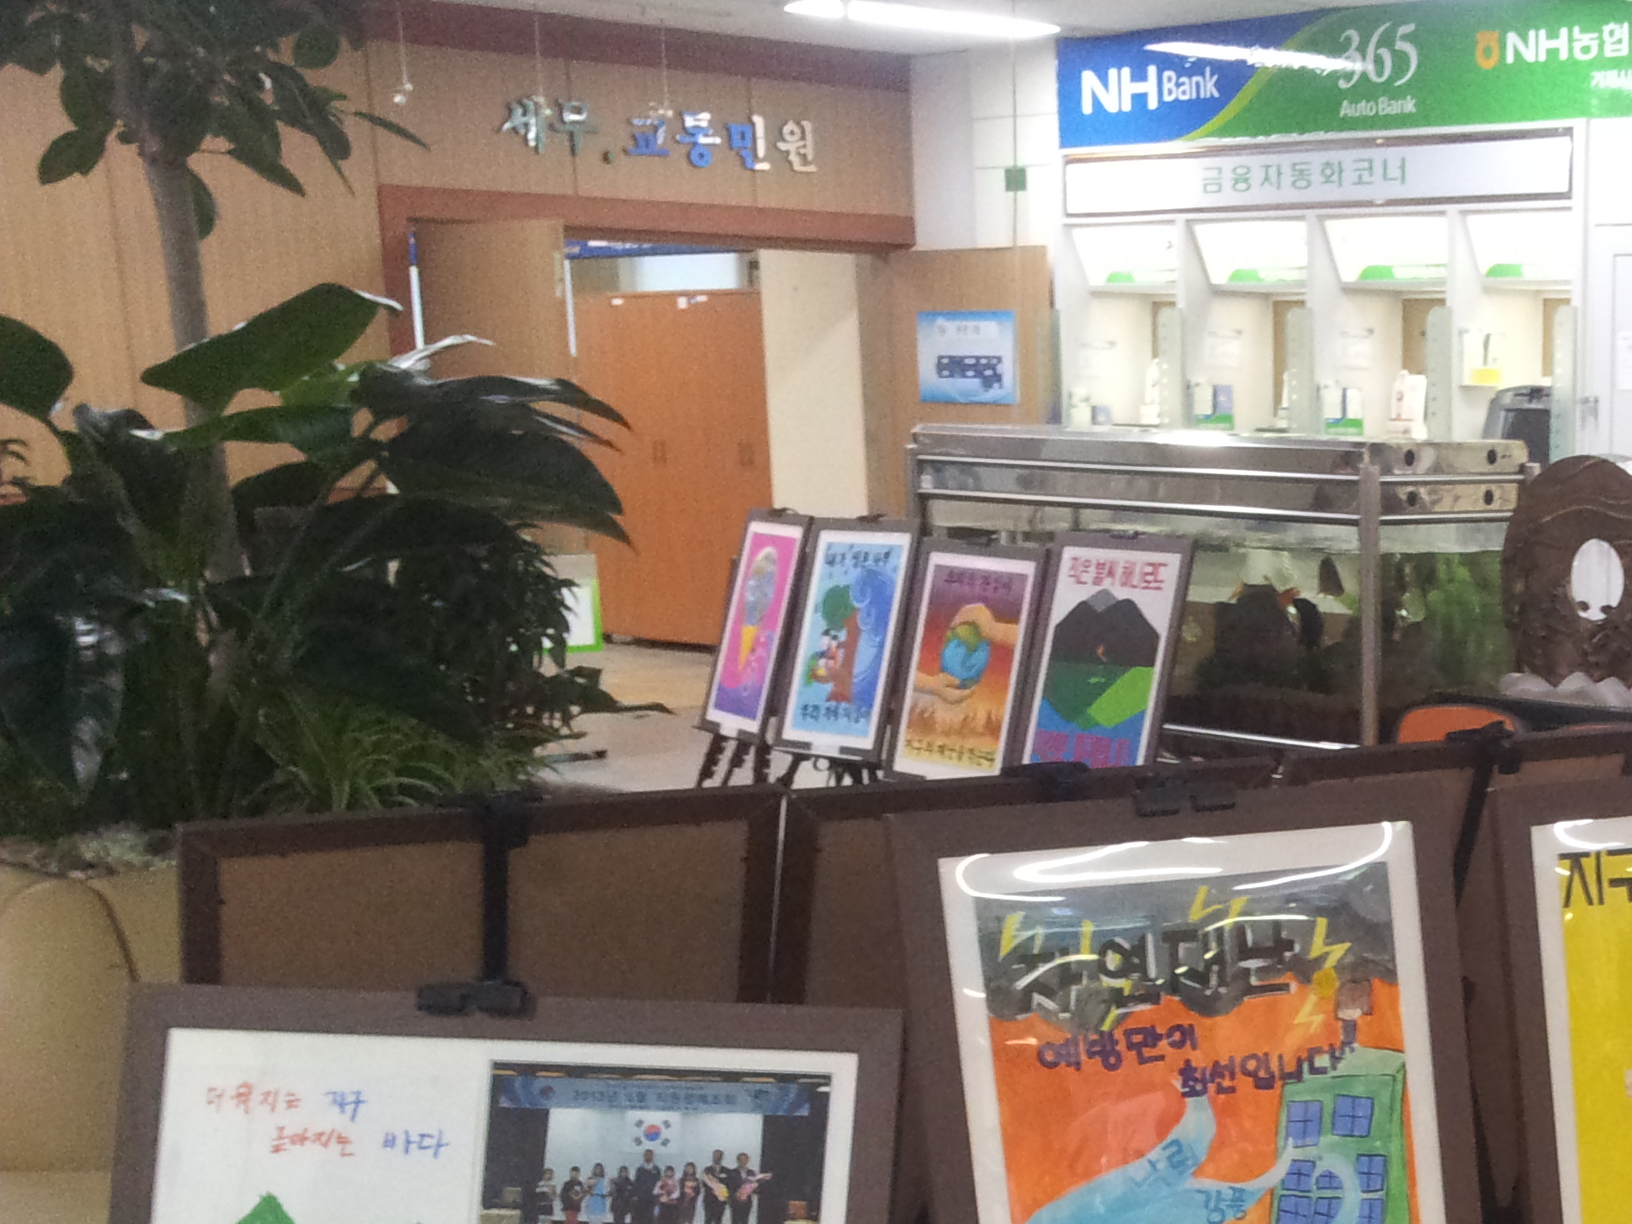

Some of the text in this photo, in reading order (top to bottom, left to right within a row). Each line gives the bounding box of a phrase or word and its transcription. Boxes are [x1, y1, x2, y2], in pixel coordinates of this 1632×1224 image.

[1337, 20, 1418, 90] 365
[1081, 65, 1220, 115] NH Bank
[1339, 97, 1417, 119] Auto Bank
[1202, 156, 1407, 195] 금융자동화코너
[381, 1128, 450, 1160] 바다
